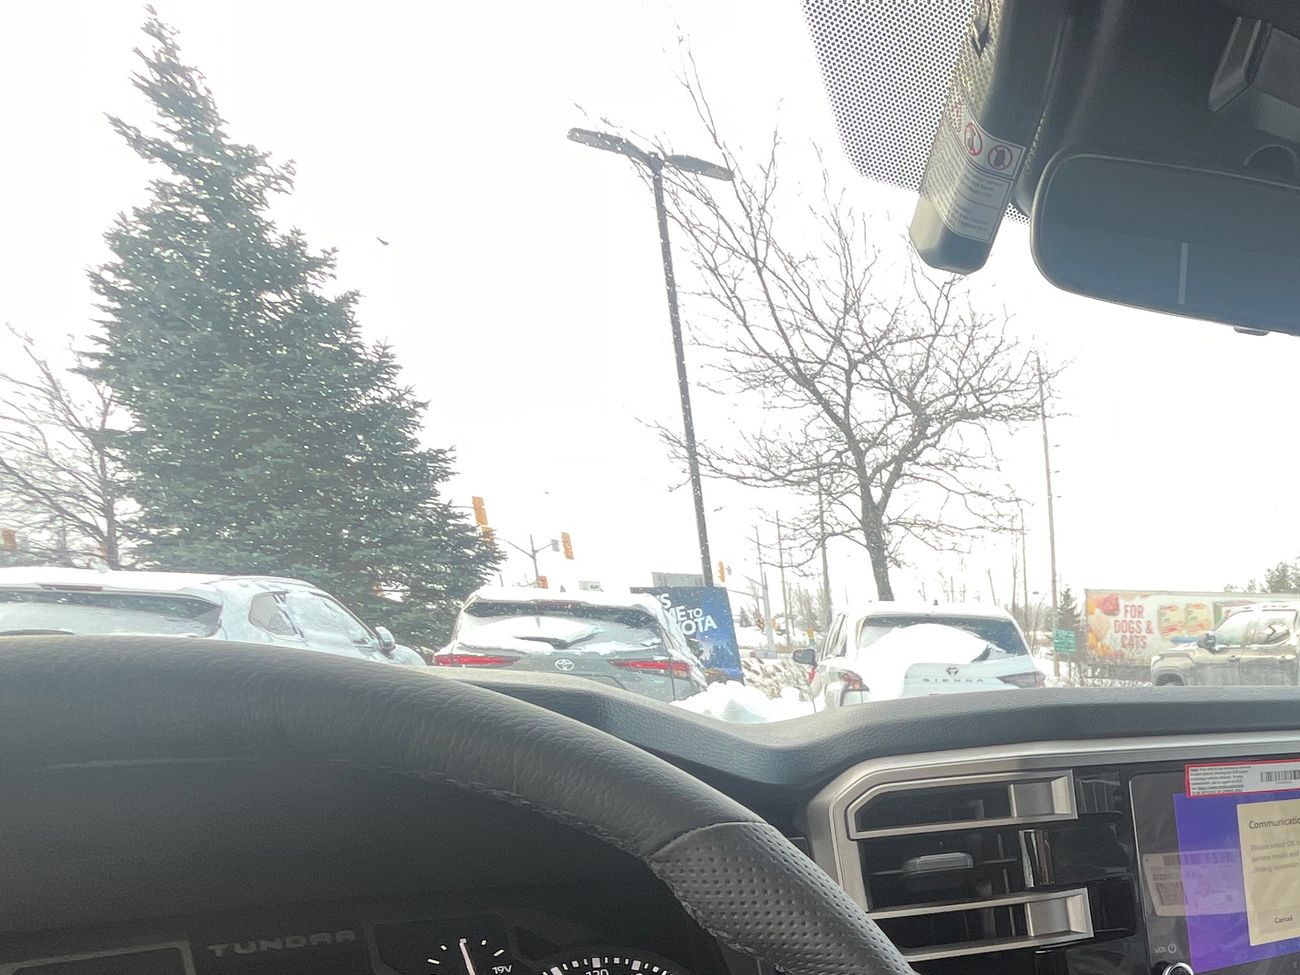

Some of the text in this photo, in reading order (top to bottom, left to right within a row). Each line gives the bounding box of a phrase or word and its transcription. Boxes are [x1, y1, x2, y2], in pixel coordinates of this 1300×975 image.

[688, 608, 702, 619] TO
[1124, 605, 1144, 619] FOR
[677, 615, 718, 635] OTA
[1114, 620, 1154, 633] DOGS &
[1120, 636, 1147, 650] CATS
[1274, 915, 1293, 924] Cancel
[206, 929, 357, 957] TUNDRA
[491, 964, 512, 975] 19V
